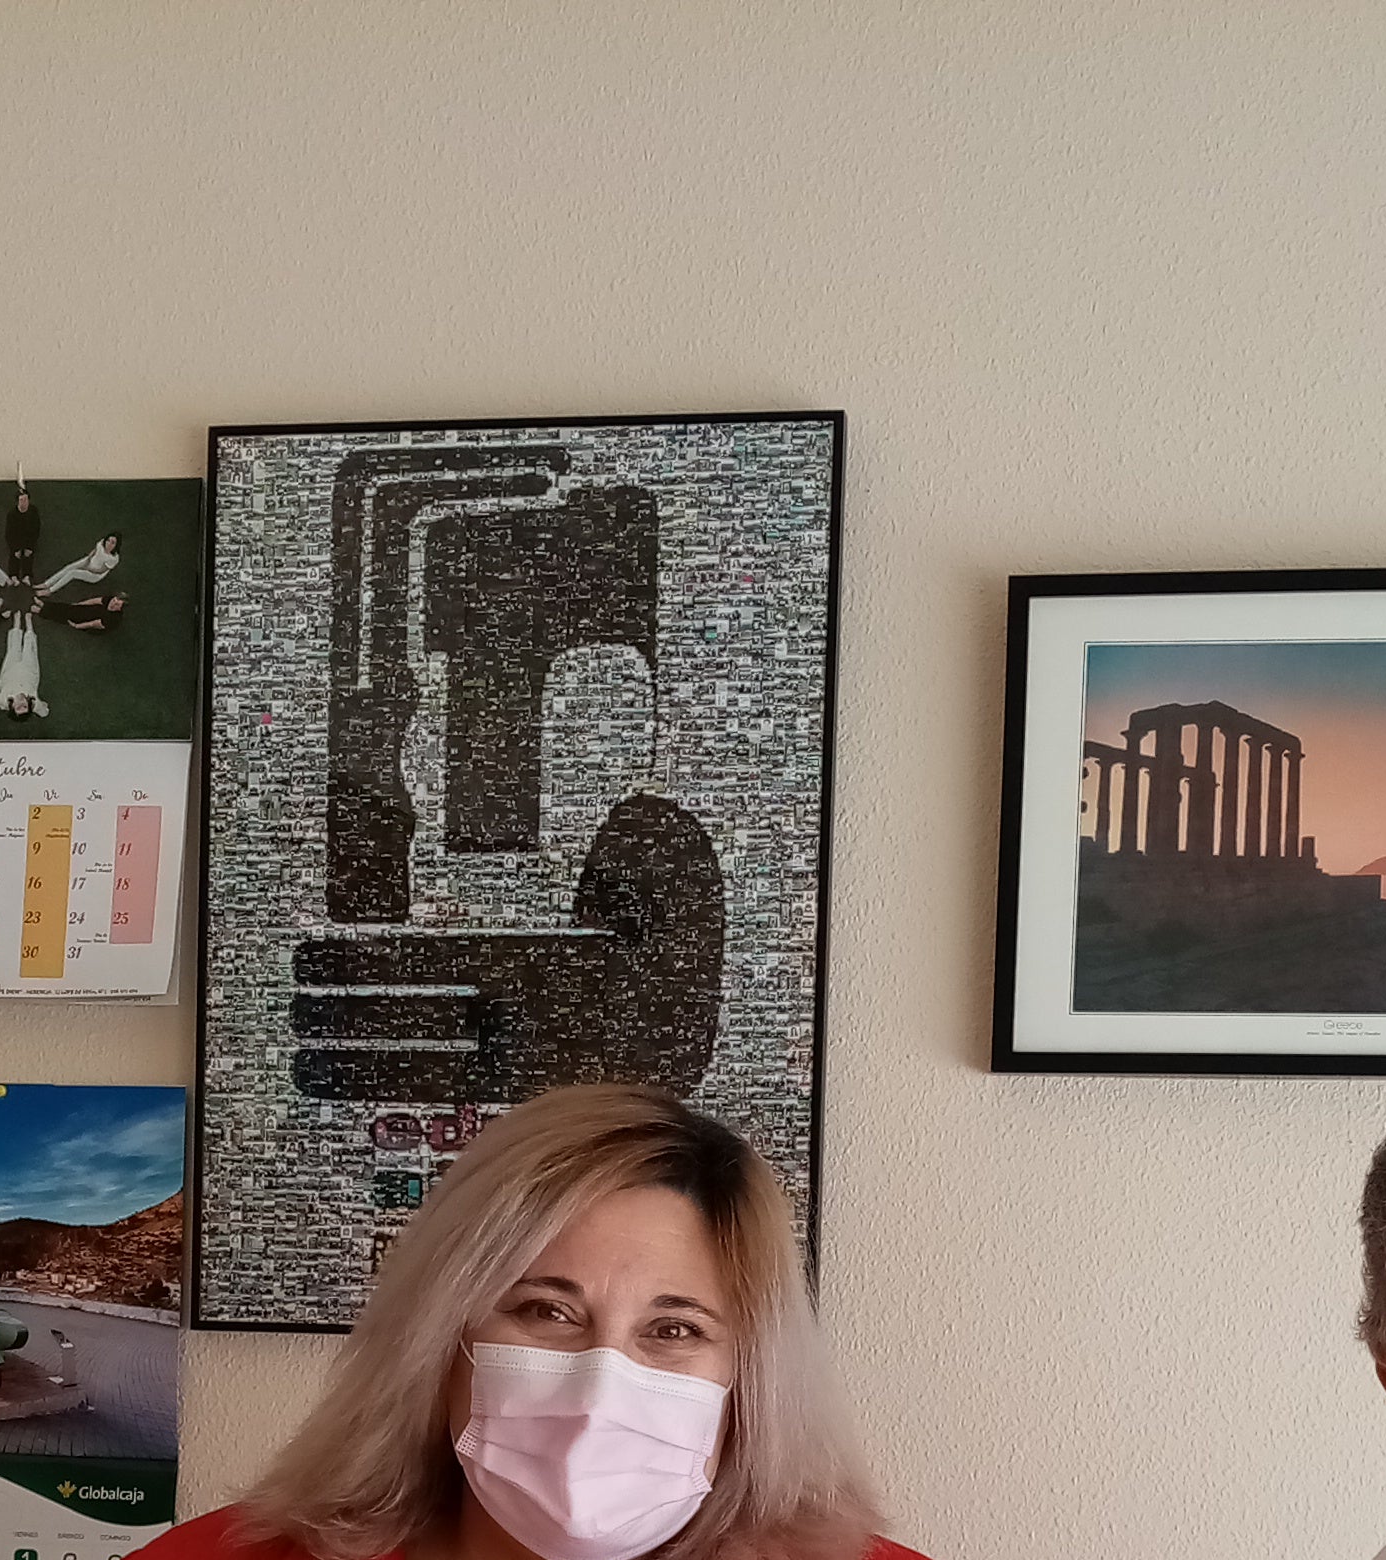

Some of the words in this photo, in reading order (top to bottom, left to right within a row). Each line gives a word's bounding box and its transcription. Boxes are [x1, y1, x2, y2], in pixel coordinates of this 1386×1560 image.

[32, 807, 41, 820] 2
[76, 807, 86, 820] 3
[121, 808, 130, 820] 4
[32, 842, 41, 854] 9
[72, 843, 87, 855] 10
[118, 843, 132, 856] 11
[27, 877, 42, 890] 16
[71, 877, 87, 890] 17
[116, 878, 131, 891] 18
[24, 911, 41, 924] 23
[68, 912, 85, 925] 24
[113, 912, 129, 925] 25
[21, 946, 39, 959] 30
[67, 946, 82, 959] 31
[78, 1485, 145, 1505] Globalcaja
